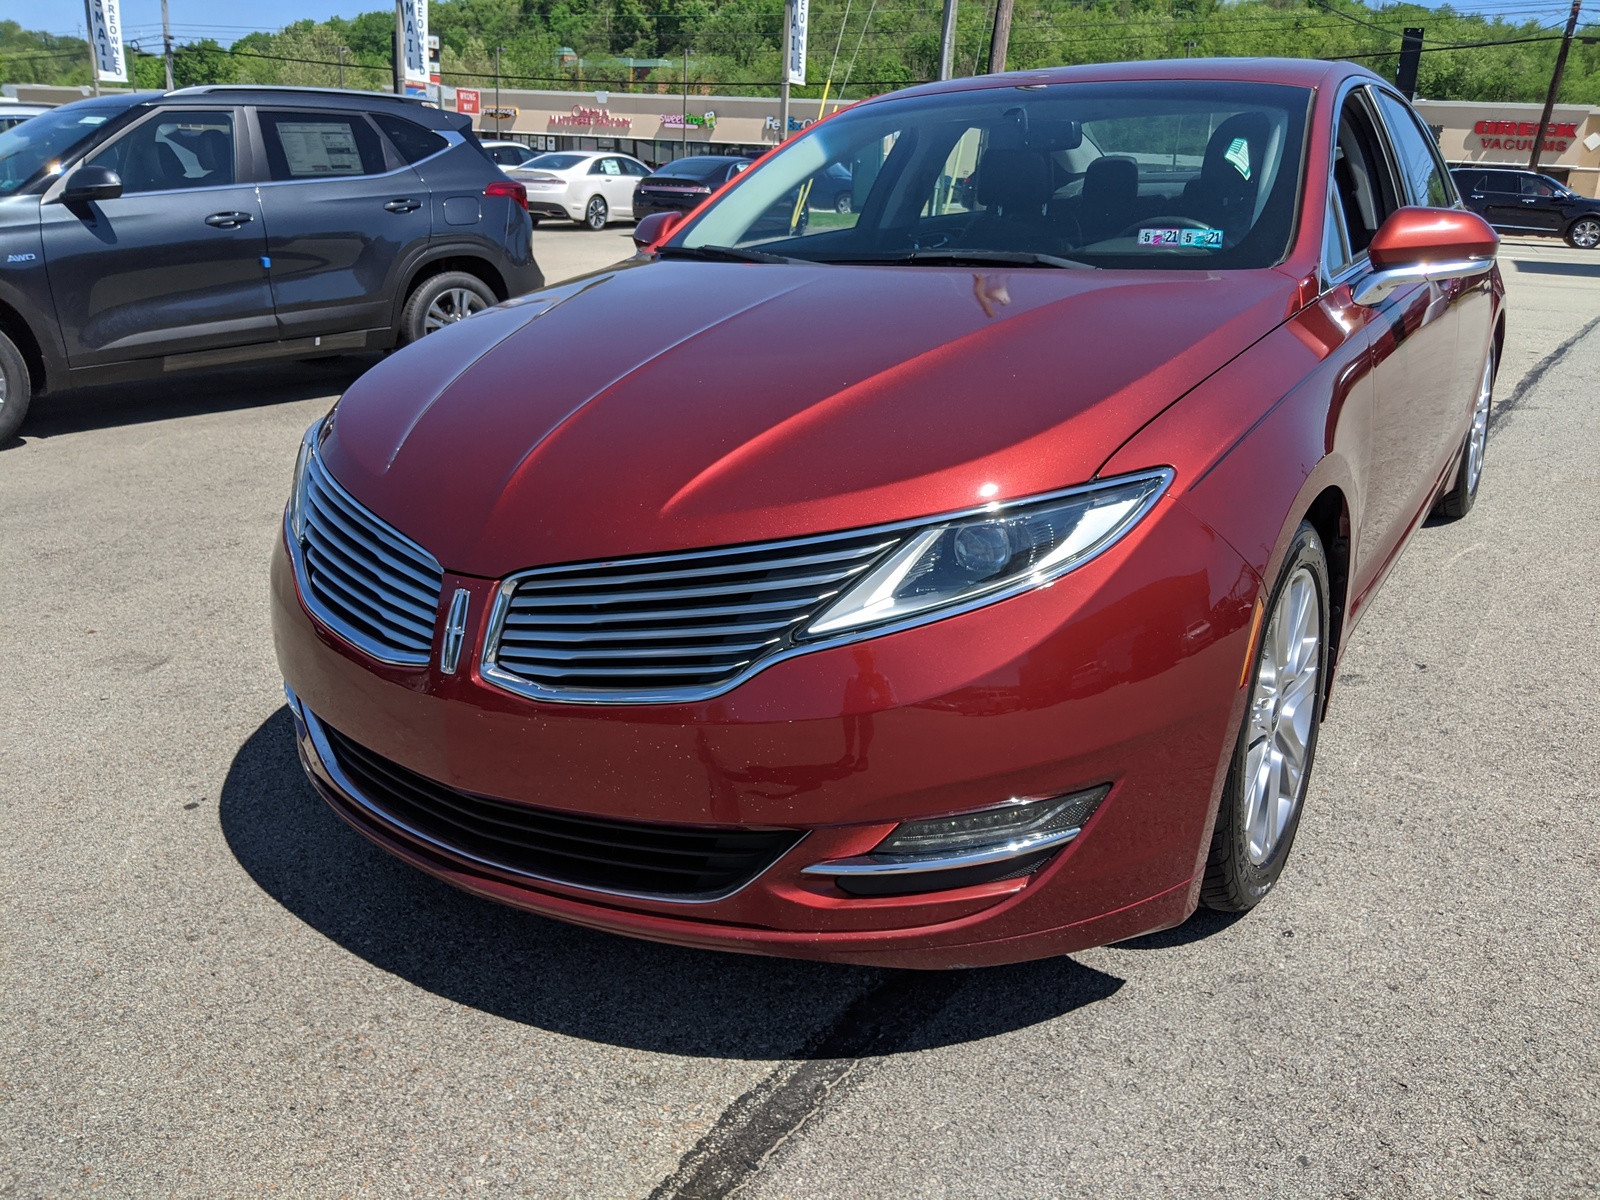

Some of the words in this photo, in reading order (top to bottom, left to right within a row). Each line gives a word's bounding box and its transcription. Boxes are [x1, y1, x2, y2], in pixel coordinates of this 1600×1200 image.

[460, 92, 476, 101] WRONG
[464, 103, 473, 111] WAY
[1474, 120, 1578, 138] ORECK
[1165, 230, 1178, 243] 21
[1208, 232, 1221, 245] 21
[7, 253, 36, 263] AWD
